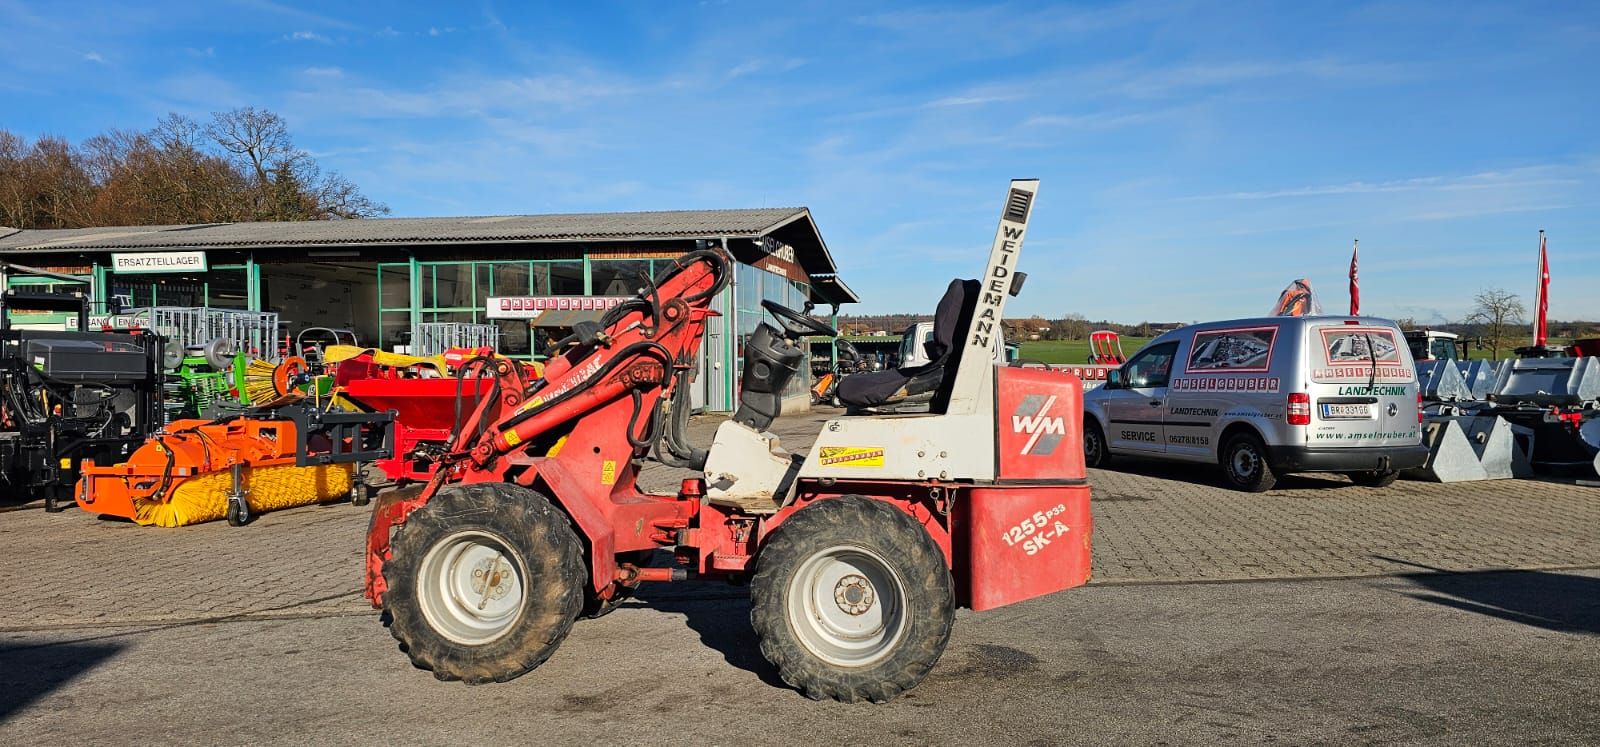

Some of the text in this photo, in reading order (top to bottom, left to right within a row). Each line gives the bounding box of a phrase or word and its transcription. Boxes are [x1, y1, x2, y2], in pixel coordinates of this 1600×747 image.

[118, 256, 200, 267] ERSATZTEILLAGER
[971, 225, 1024, 347] WEIDEMANN
[1174, 378, 1280, 392] AMSELGRUBER
[1338, 386, 1407, 396] LANDTECHNIK
[1170, 407, 1220, 417] LANDTECHNIK
[1121, 430, 1156, 442] SERVICE
[1022, 520, 1071, 556] SK-A
